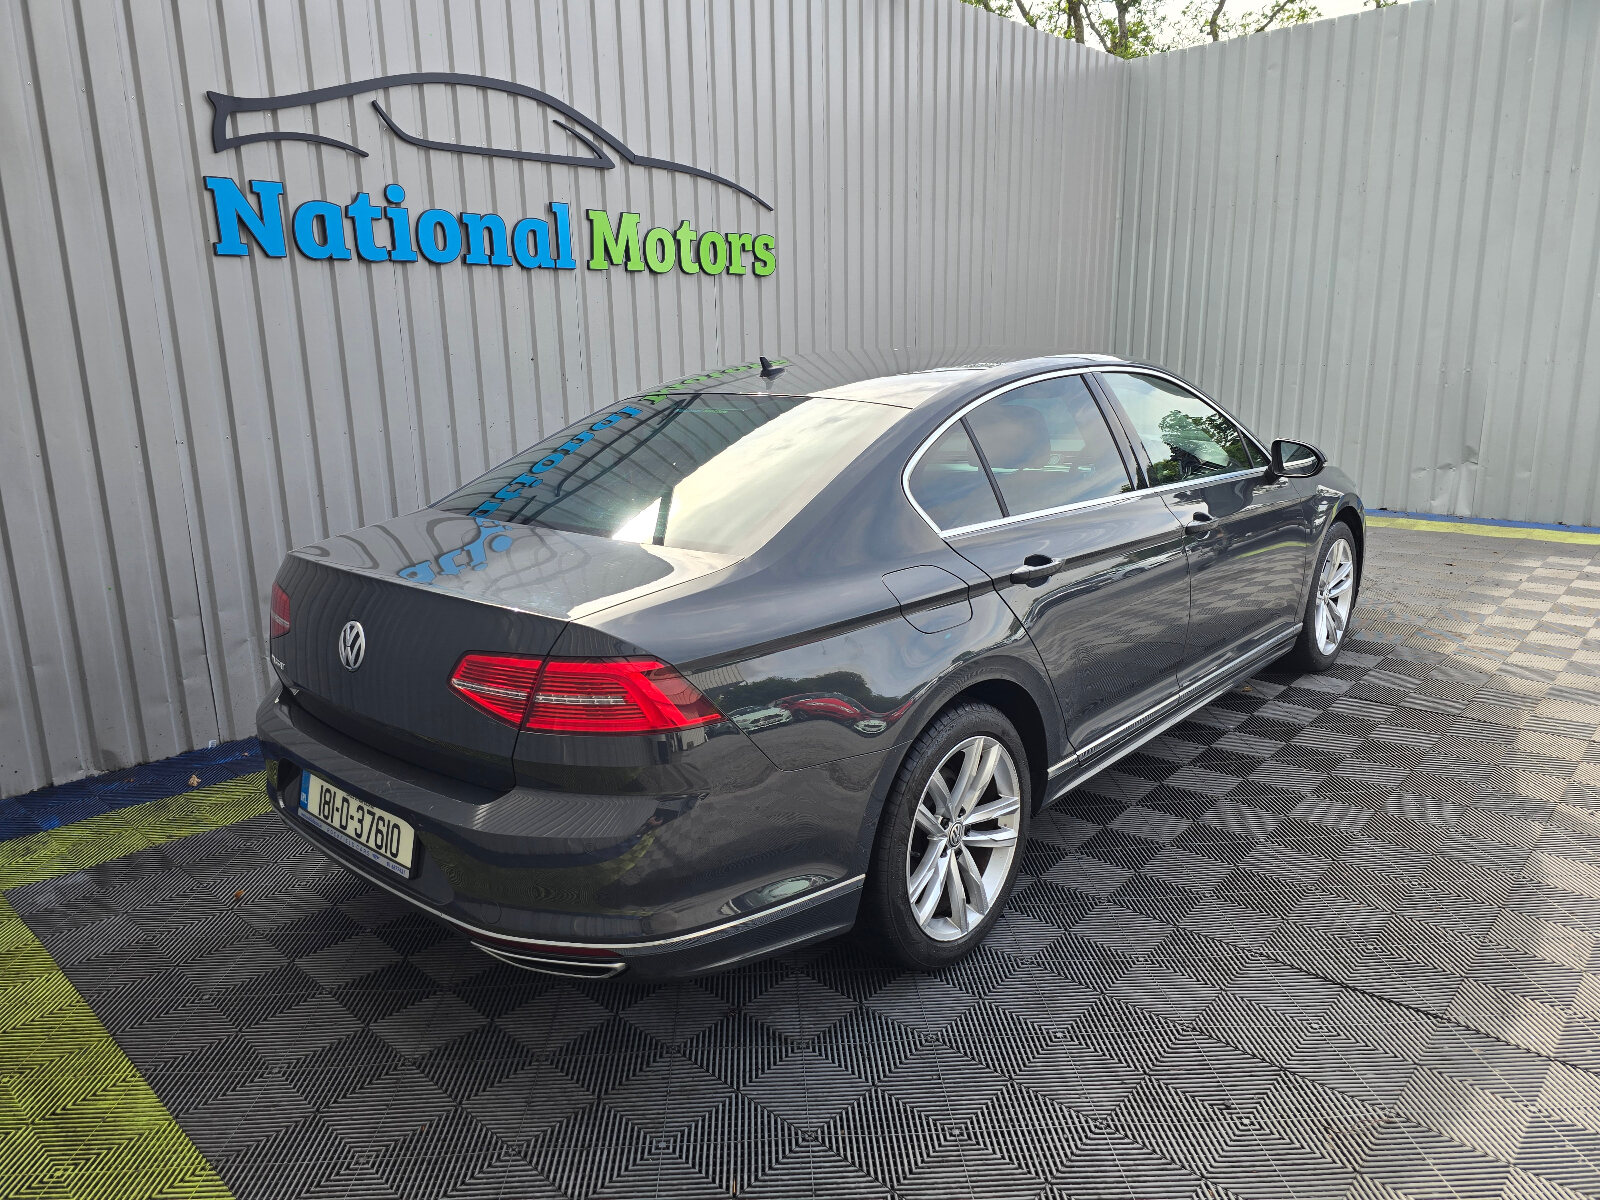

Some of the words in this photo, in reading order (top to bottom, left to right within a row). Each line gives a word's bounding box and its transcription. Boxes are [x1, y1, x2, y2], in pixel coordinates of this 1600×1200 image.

[204, 176, 577, 270] National
[587, 208, 777, 277] Motors
[318, 784, 401, 859] 181-D-37610
